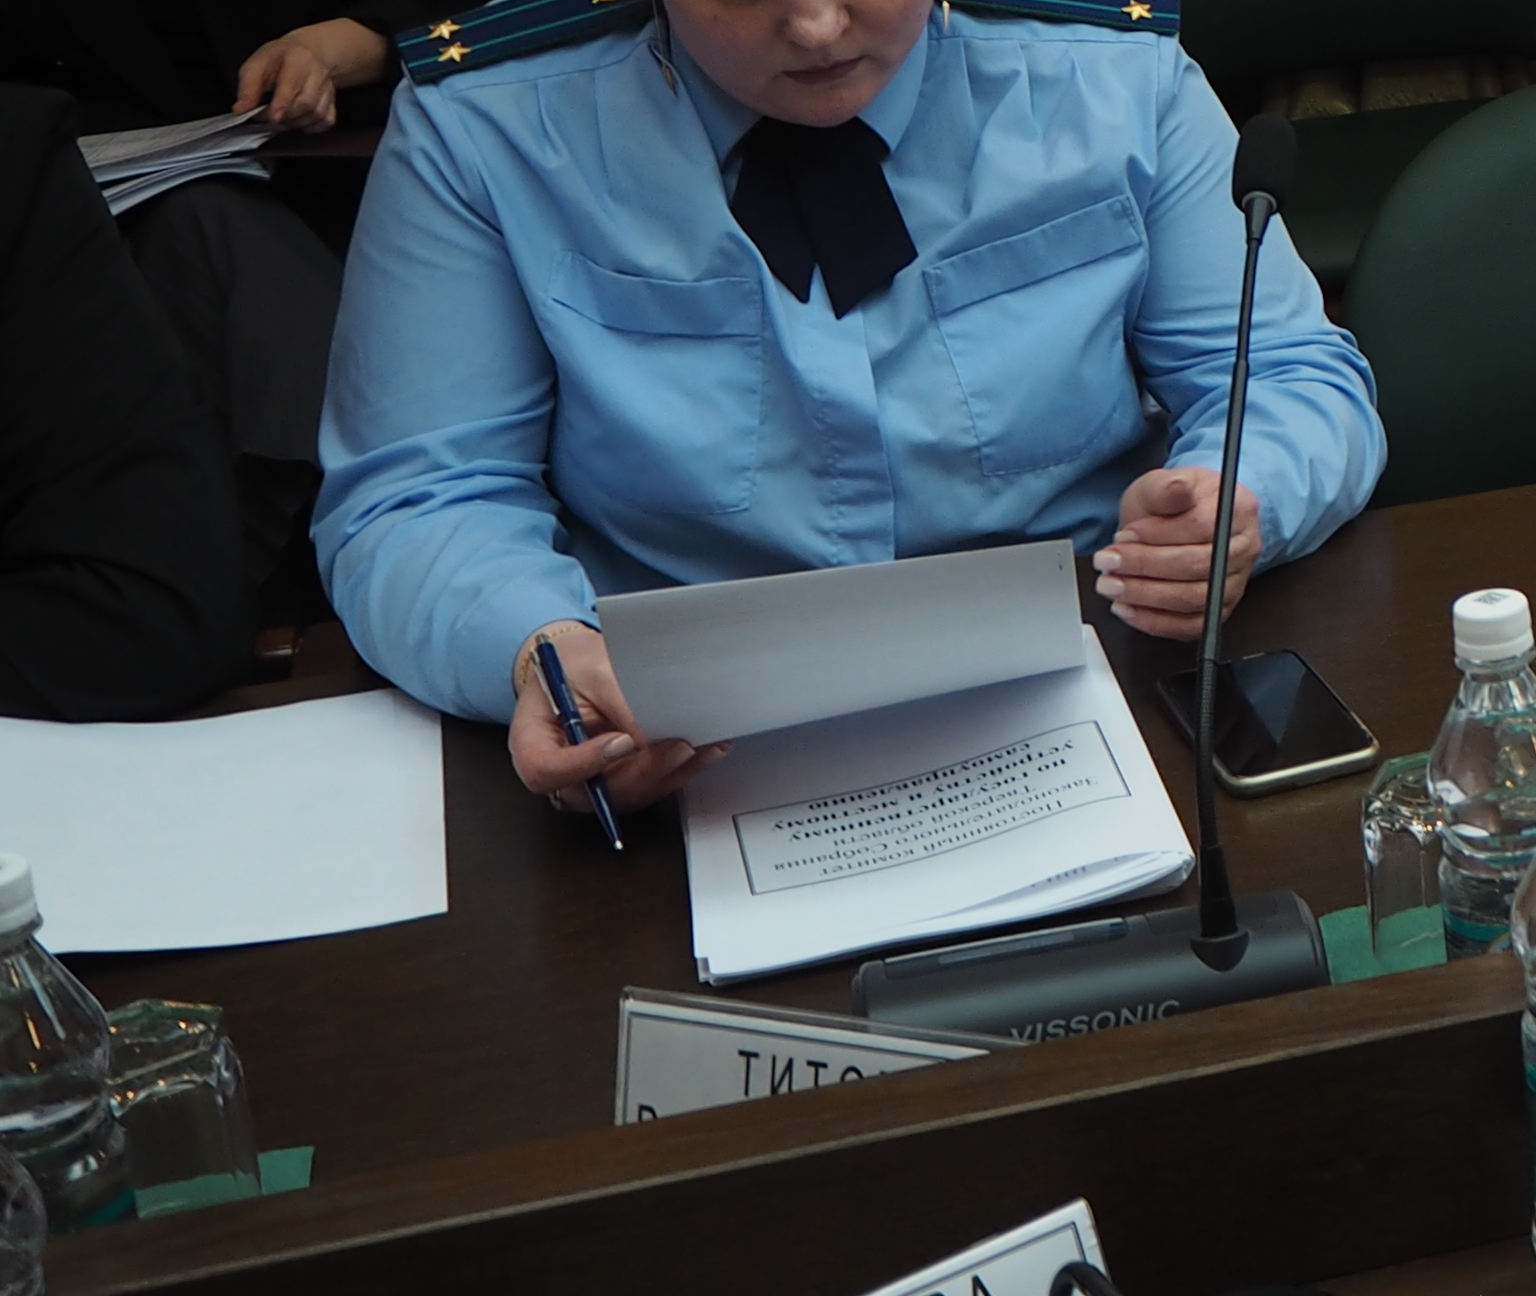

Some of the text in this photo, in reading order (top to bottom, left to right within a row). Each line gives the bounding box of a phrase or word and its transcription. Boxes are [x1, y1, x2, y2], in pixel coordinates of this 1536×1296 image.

[772, 740, 1074, 833] устройству и местному
[789, 758, 1066, 842] по государственному
[808, 742, 1031, 811] самоуправлению
[774, 778, 1098, 871] Законодательного Собрания
[819, 800, 1062, 877] Постоянный комитет
[832, 785, 1036, 847] Тверской области
[1010, 999, 1180, 1043] VISSONIC
